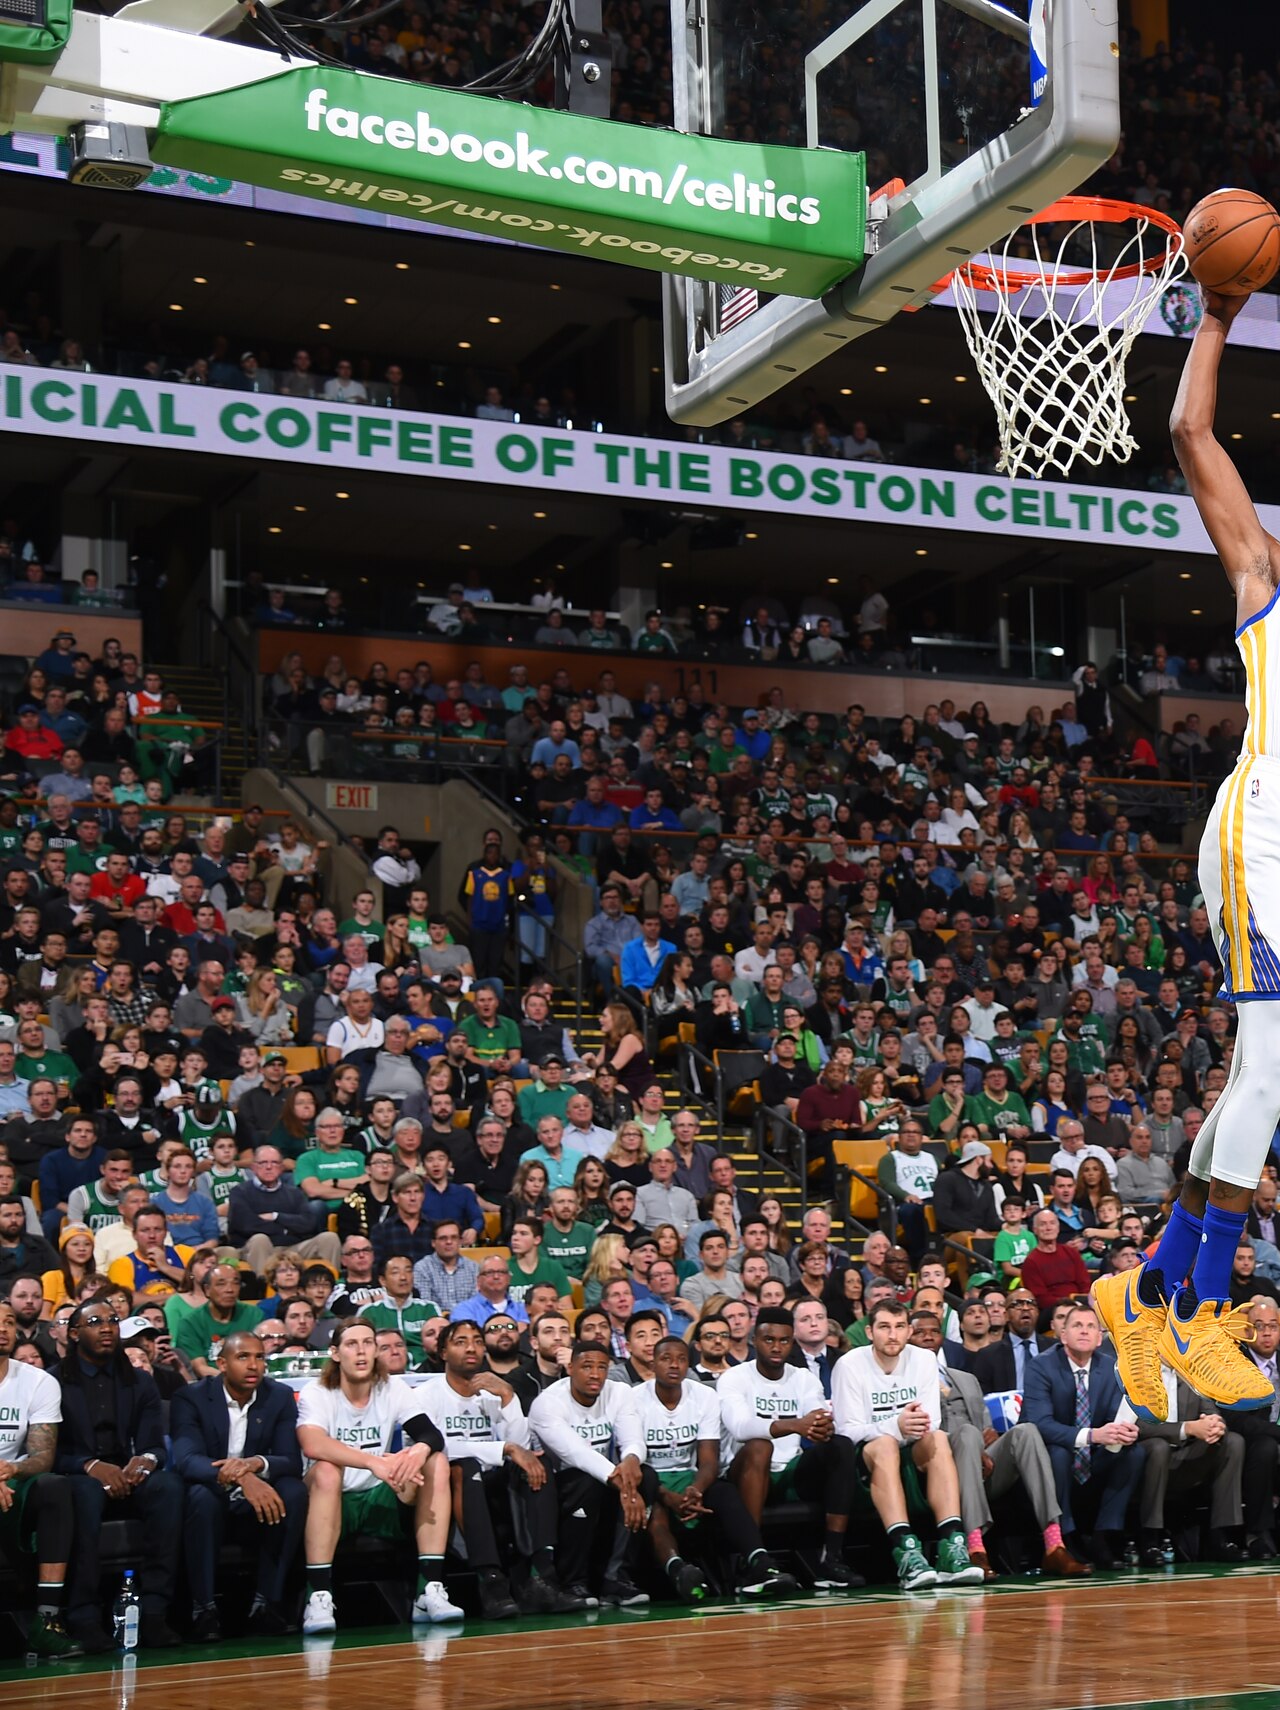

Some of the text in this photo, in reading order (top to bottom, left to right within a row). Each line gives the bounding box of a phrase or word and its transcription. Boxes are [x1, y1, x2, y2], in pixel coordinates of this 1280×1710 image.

[304, 89, 821, 225] facebook.com/celtics
[279, 167, 788, 282] facebook.com/celtics
[219, 402, 474, 468] COFFEE
[495, 433, 575, 478] OF
[594, 442, 711, 493] THE
[729, 458, 956, 518] BOSTON
[974, 485, 1180, 539] CELTICS
[336, 786, 372, 808] EXIT
[756, 1396, 798, 1412] BOSTON
[872, 1386, 917, 1405] BOSTON
[446, 1415, 492, 1430] BOSTON
[570, 1421, 613, 1439] OSTON
[336, 1426, 381, 1442] BOSTON
[647, 1423, 699, 1441] BOSTON
